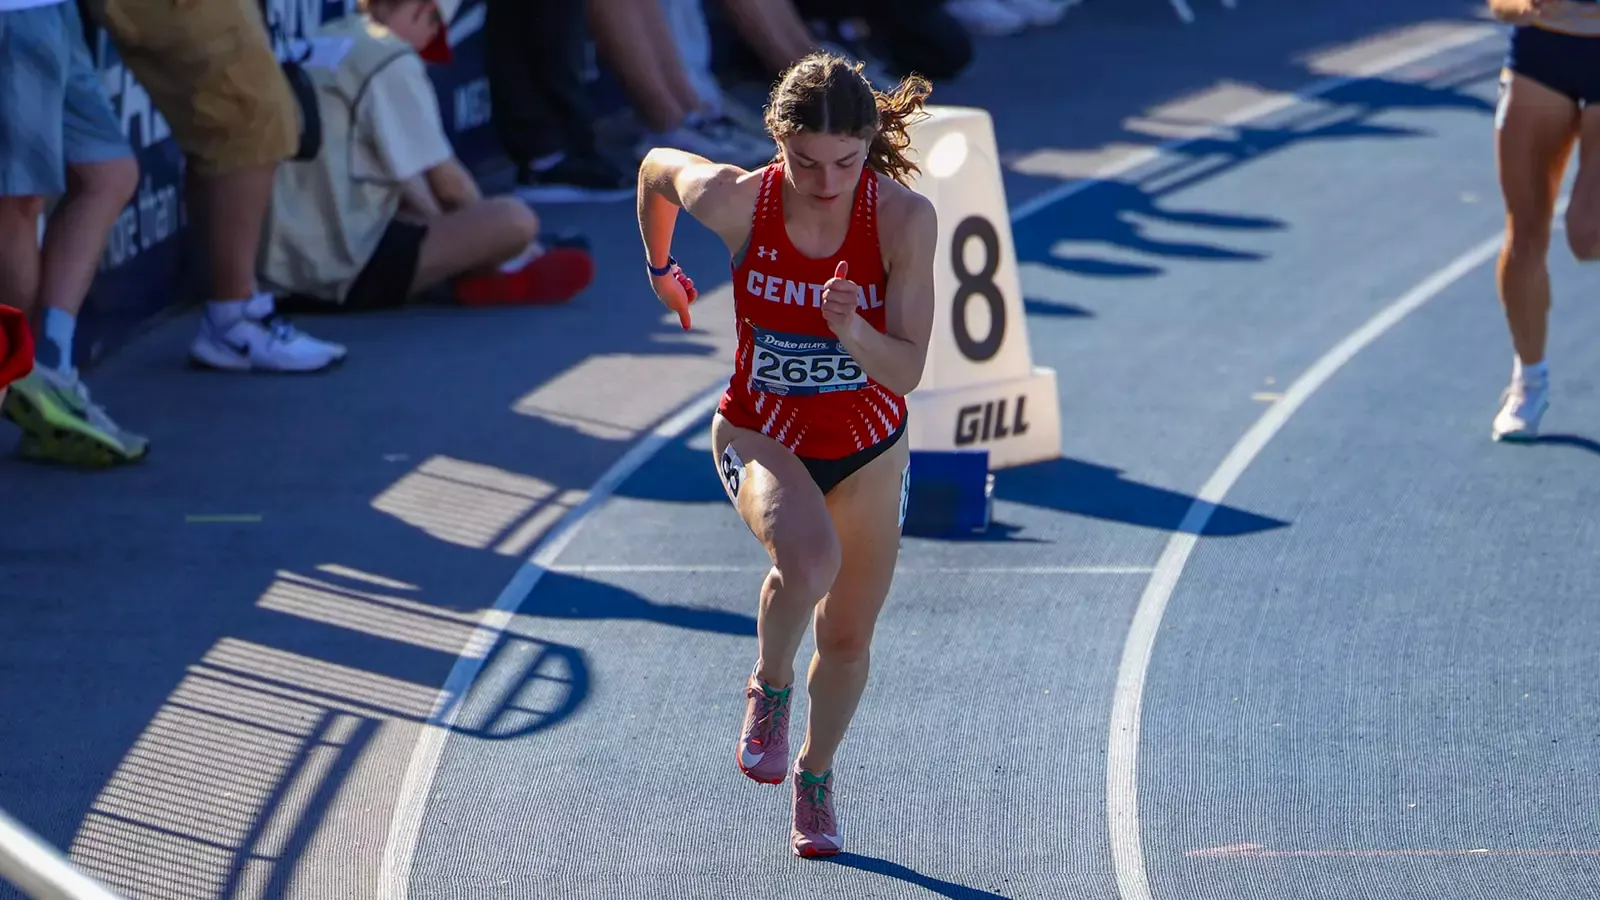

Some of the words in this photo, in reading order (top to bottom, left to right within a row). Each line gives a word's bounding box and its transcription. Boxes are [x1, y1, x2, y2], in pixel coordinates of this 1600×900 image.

[746, 269, 884, 311] CENTAL
[951, 215, 1007, 363] 8
[764, 334, 798, 349] Drake
[798, 342, 827, 350] RELAYS
[756, 351, 862, 383] 2655
[954, 395, 1030, 447] GILL
